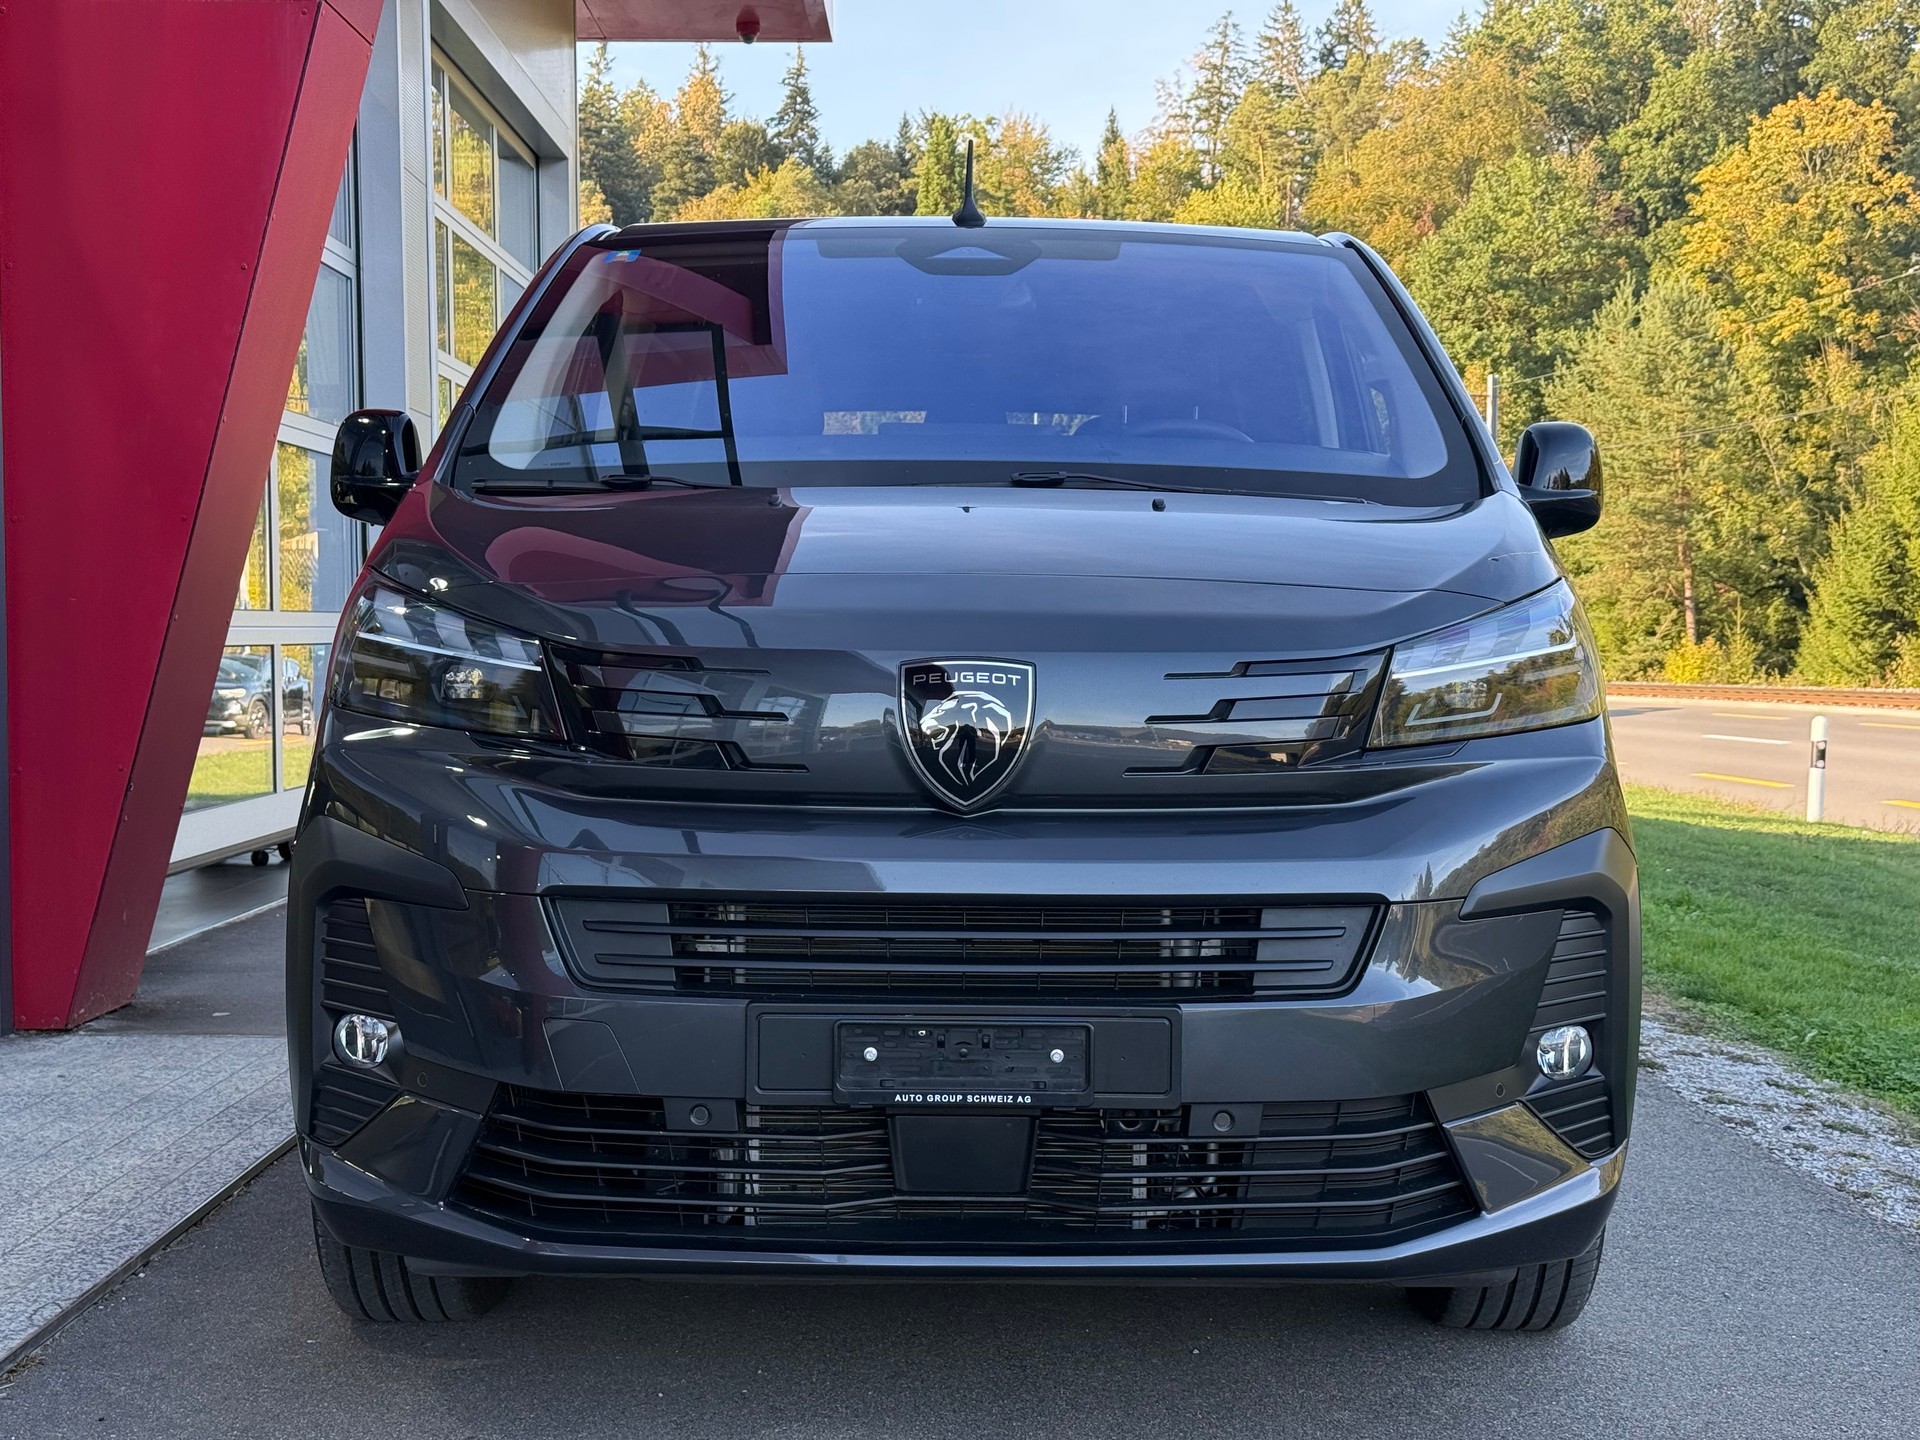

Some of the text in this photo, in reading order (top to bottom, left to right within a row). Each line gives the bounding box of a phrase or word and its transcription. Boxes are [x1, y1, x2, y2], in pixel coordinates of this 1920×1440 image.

[912, 671, 1022, 686] PEUGEOT
[894, 1094, 1032, 1103] AUTO GROUP SCHWEIZ AG
